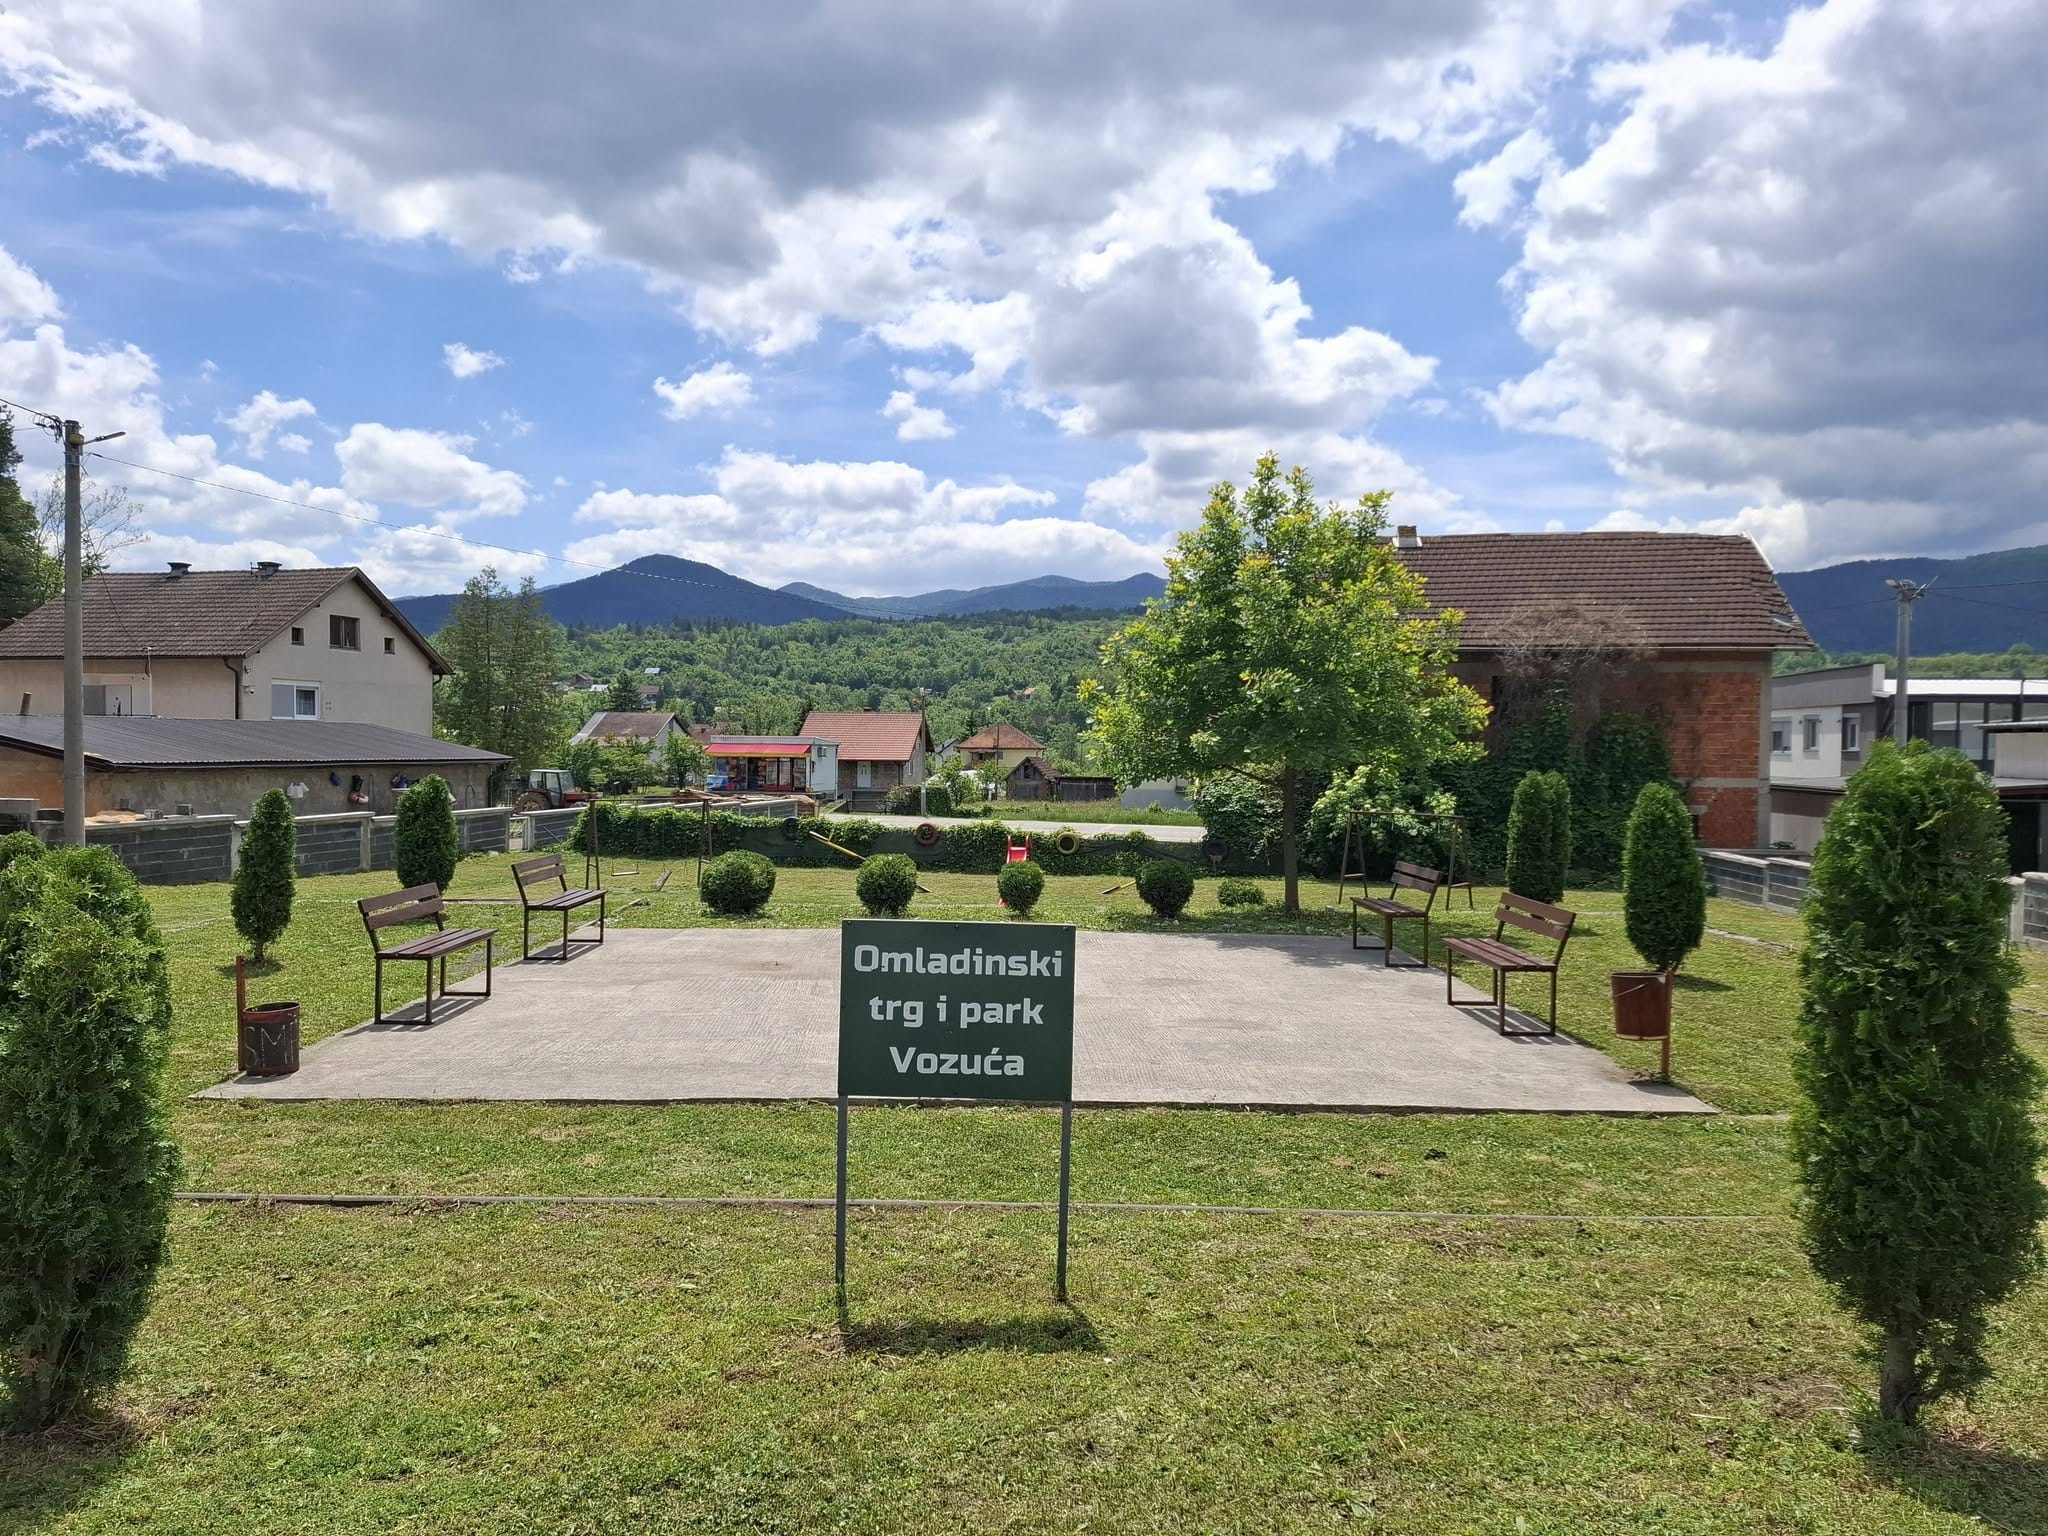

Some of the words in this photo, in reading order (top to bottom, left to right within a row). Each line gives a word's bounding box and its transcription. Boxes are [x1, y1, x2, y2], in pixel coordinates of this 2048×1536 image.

[854, 944, 1063, 978] Omladinski
[868, 996, 924, 1029] trg
[936, 995, 948, 1023] i
[959, 997, 1045, 1029] park
[889, 1046, 1025, 1077] Vozuća
